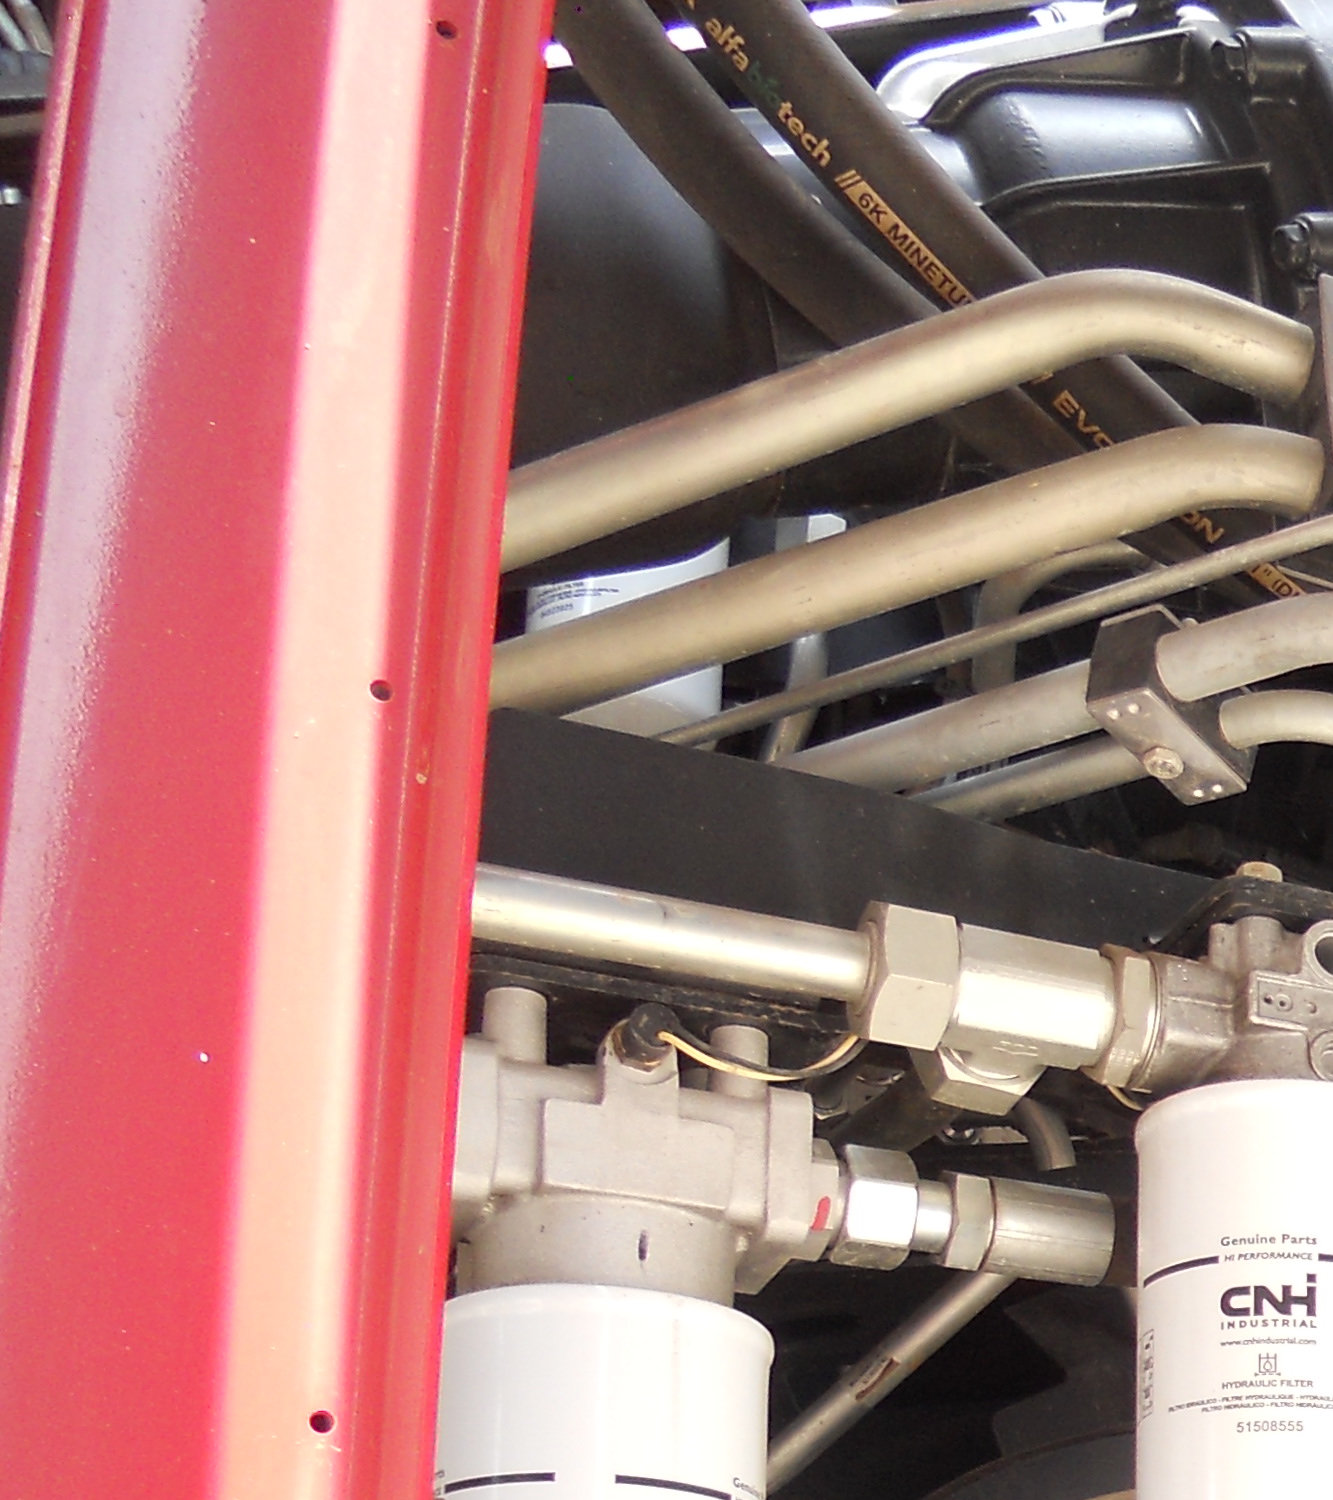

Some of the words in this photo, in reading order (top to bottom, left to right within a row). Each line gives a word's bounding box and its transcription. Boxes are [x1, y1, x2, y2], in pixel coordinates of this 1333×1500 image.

[855, 189, 889, 225] 6K
[885, 221, 971, 312] MINETU
[1221, 1234, 1276, 1247] Genuine
[1281, 1234, 1317, 1246] Parts
[1238, 1252, 1313, 1262] PERFORMANCE
[1221, 1319, 1317, 1330] INDUSTRIAL
[1220, 1337, 1317, 1347] www.cnhindustrial.com
[1221, 1379, 1277, 1390] HYDRAULIC
[1280, 1379, 1314, 1389] FILTER
[1236, 1421, 1304, 1433] 51508555
